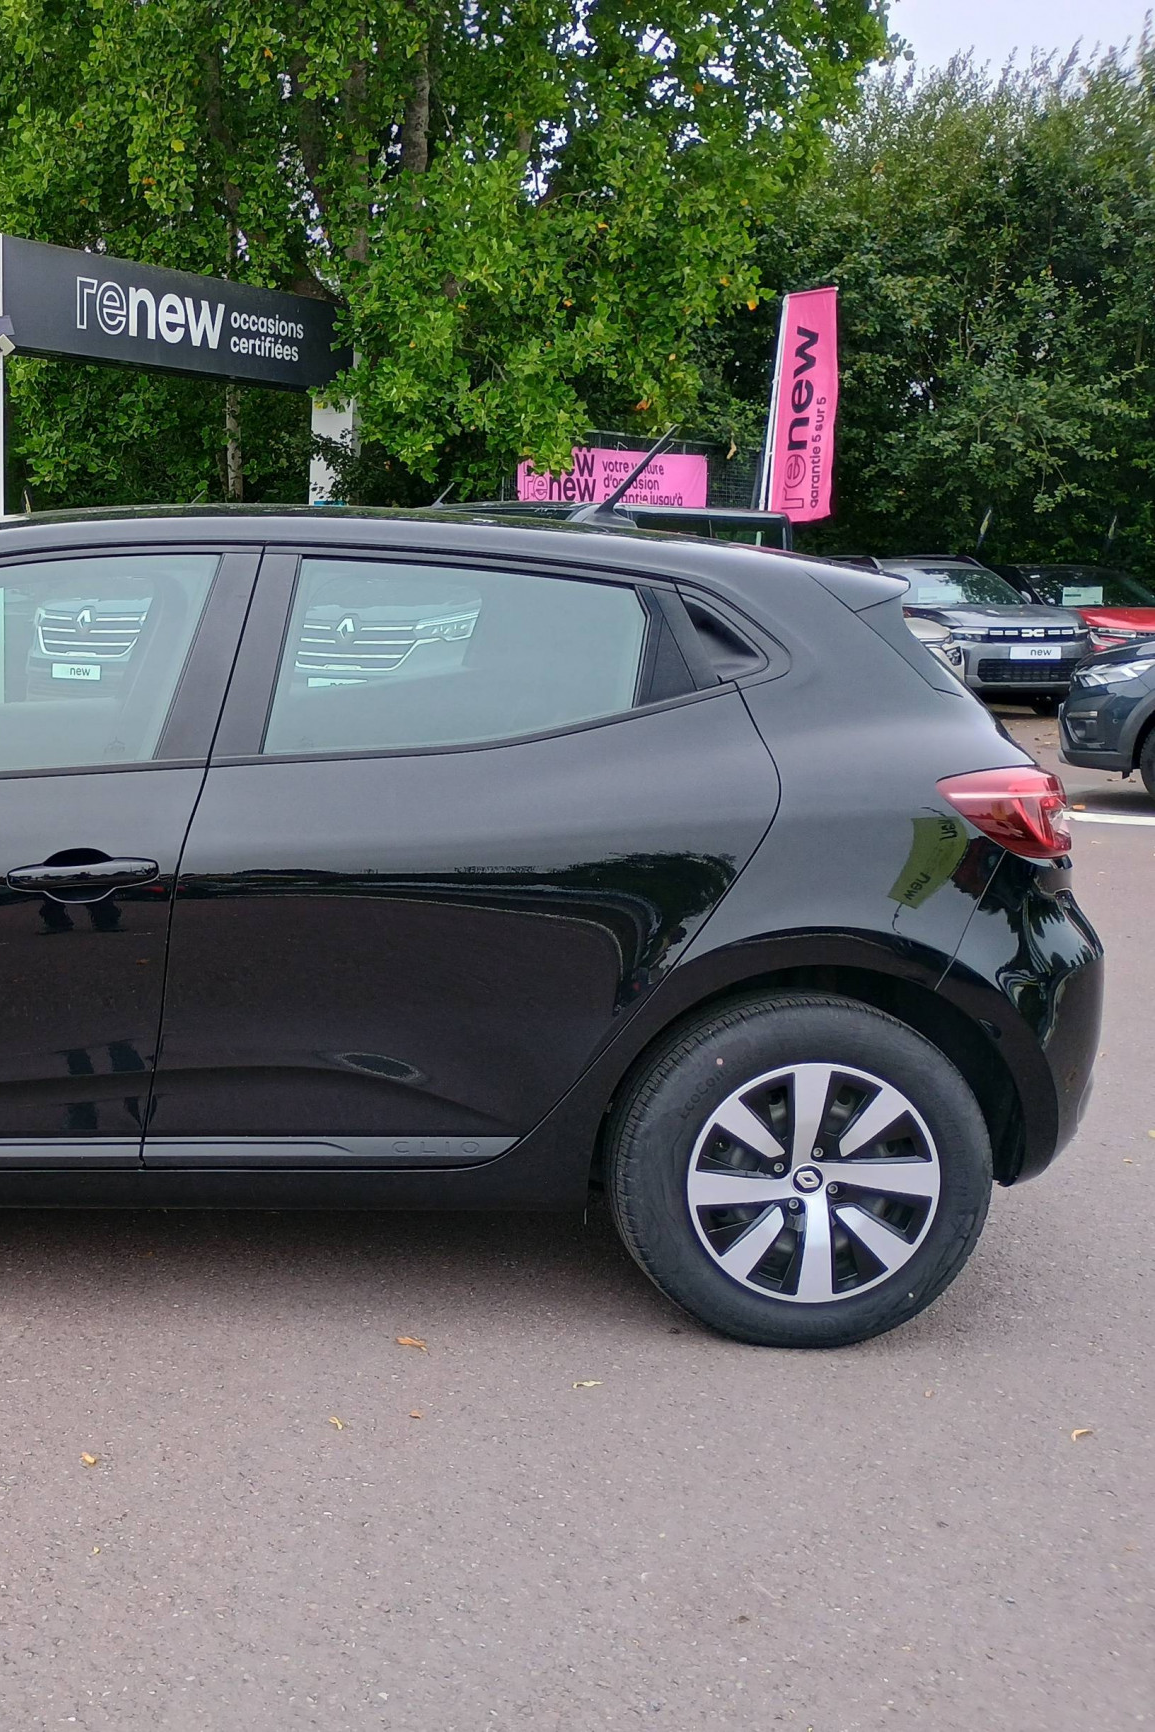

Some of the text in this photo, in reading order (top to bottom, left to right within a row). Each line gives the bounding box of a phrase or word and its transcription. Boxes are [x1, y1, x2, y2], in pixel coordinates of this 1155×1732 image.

[76, 276, 225, 349] renew
[230, 311, 304, 340] occasions
[230, 336, 299, 362] certifiées
[781, 325, 819, 510] renew
[810, 396, 827, 509] garantie 5 sur 5
[602, 460, 629, 473] votre
[523, 475, 597, 502] renew
[1030, 648, 1052, 657] new
[69, 667, 91, 676] new
[392, 1141, 480, 1154] CLIO
